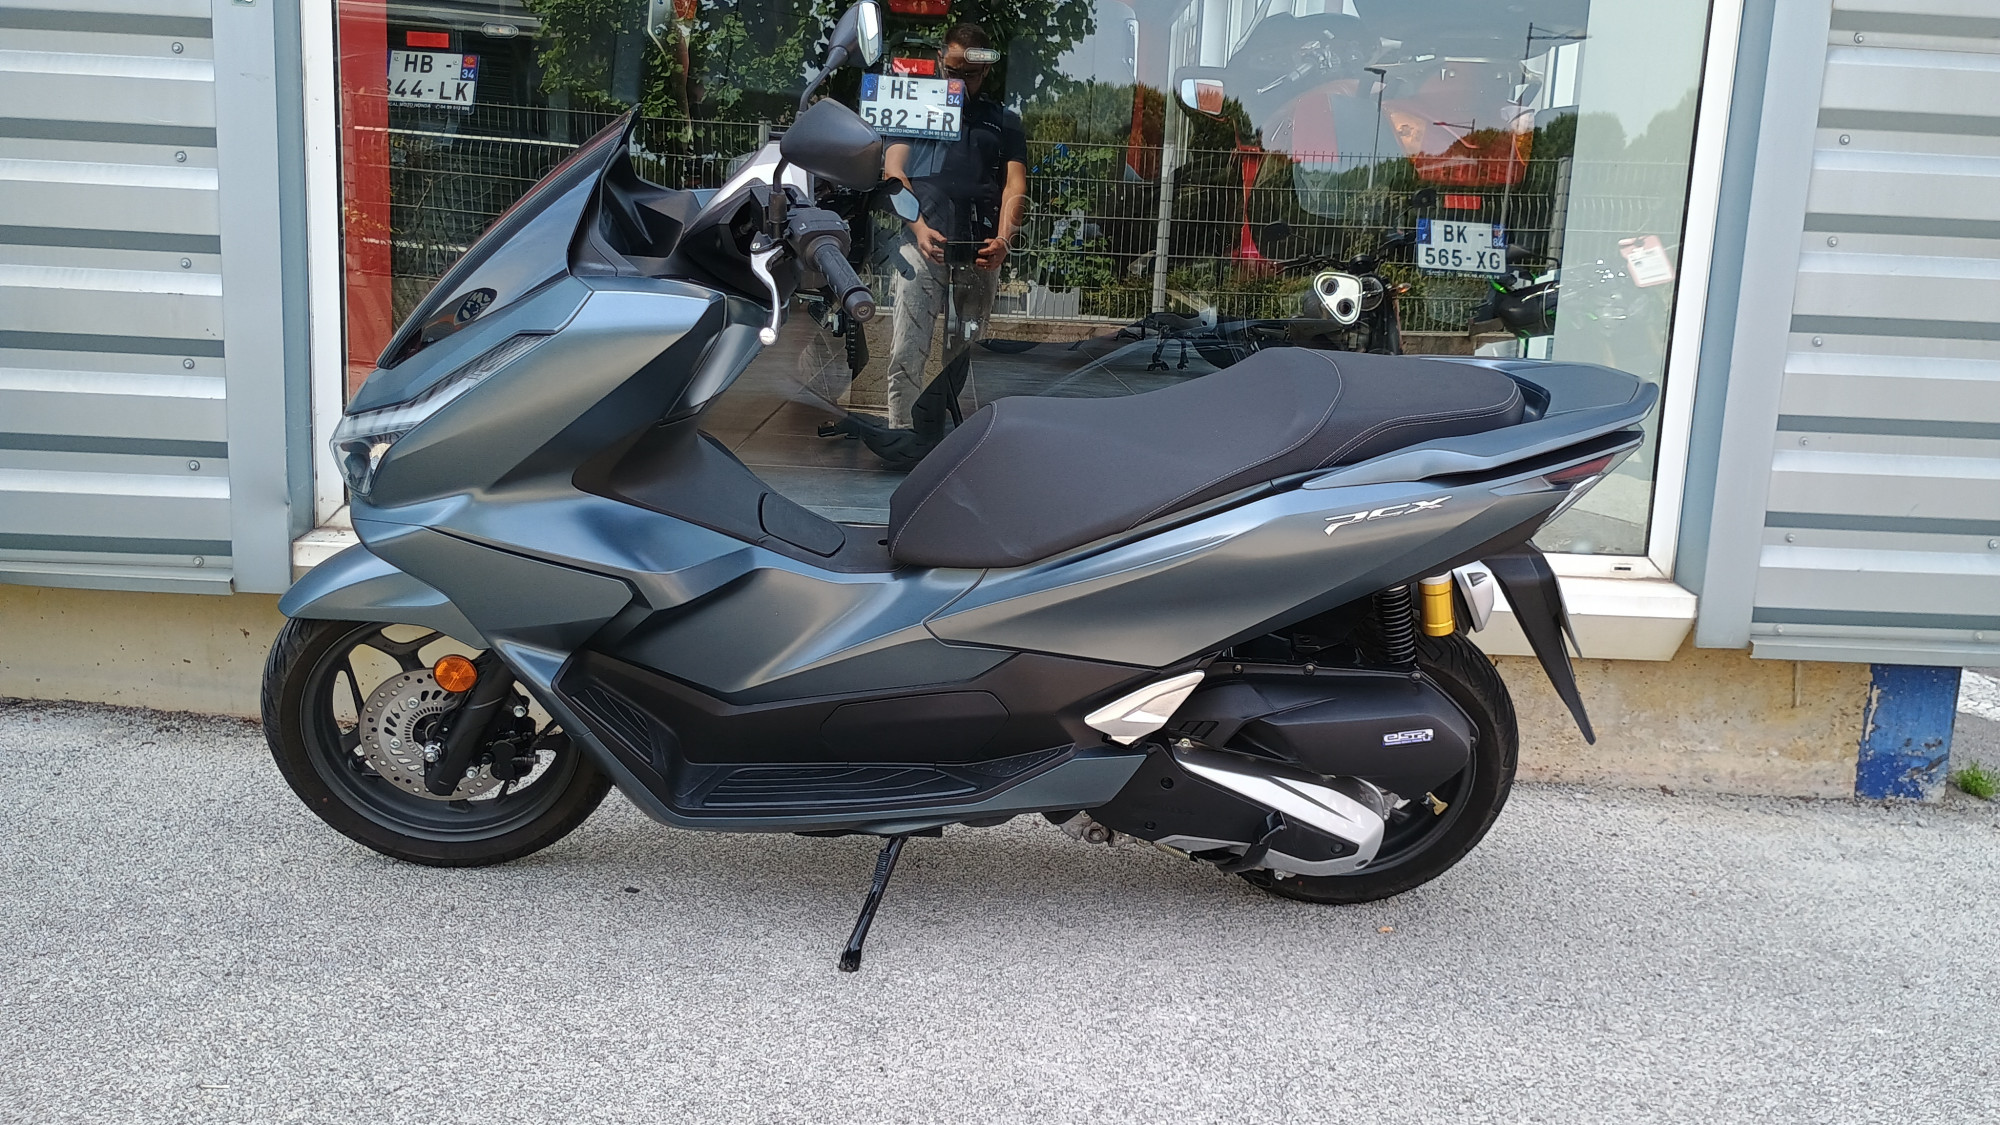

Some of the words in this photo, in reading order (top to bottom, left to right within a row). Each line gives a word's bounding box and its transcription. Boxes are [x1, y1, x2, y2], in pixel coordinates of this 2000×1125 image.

[404, 54, 433, 73] HB
[462, 69, 475, 79] 34
[891, 80, 918, 100] HE
[947, 95, 960, 105] 34
[865, 107, 955, 132] 582-FR
[1443, 224, 1467, 243] BK
[1493, 237, 1504, 247] 84
[1425, 247, 1500, 270] 565-XG
[1323, 495, 1453, 537] PCX
